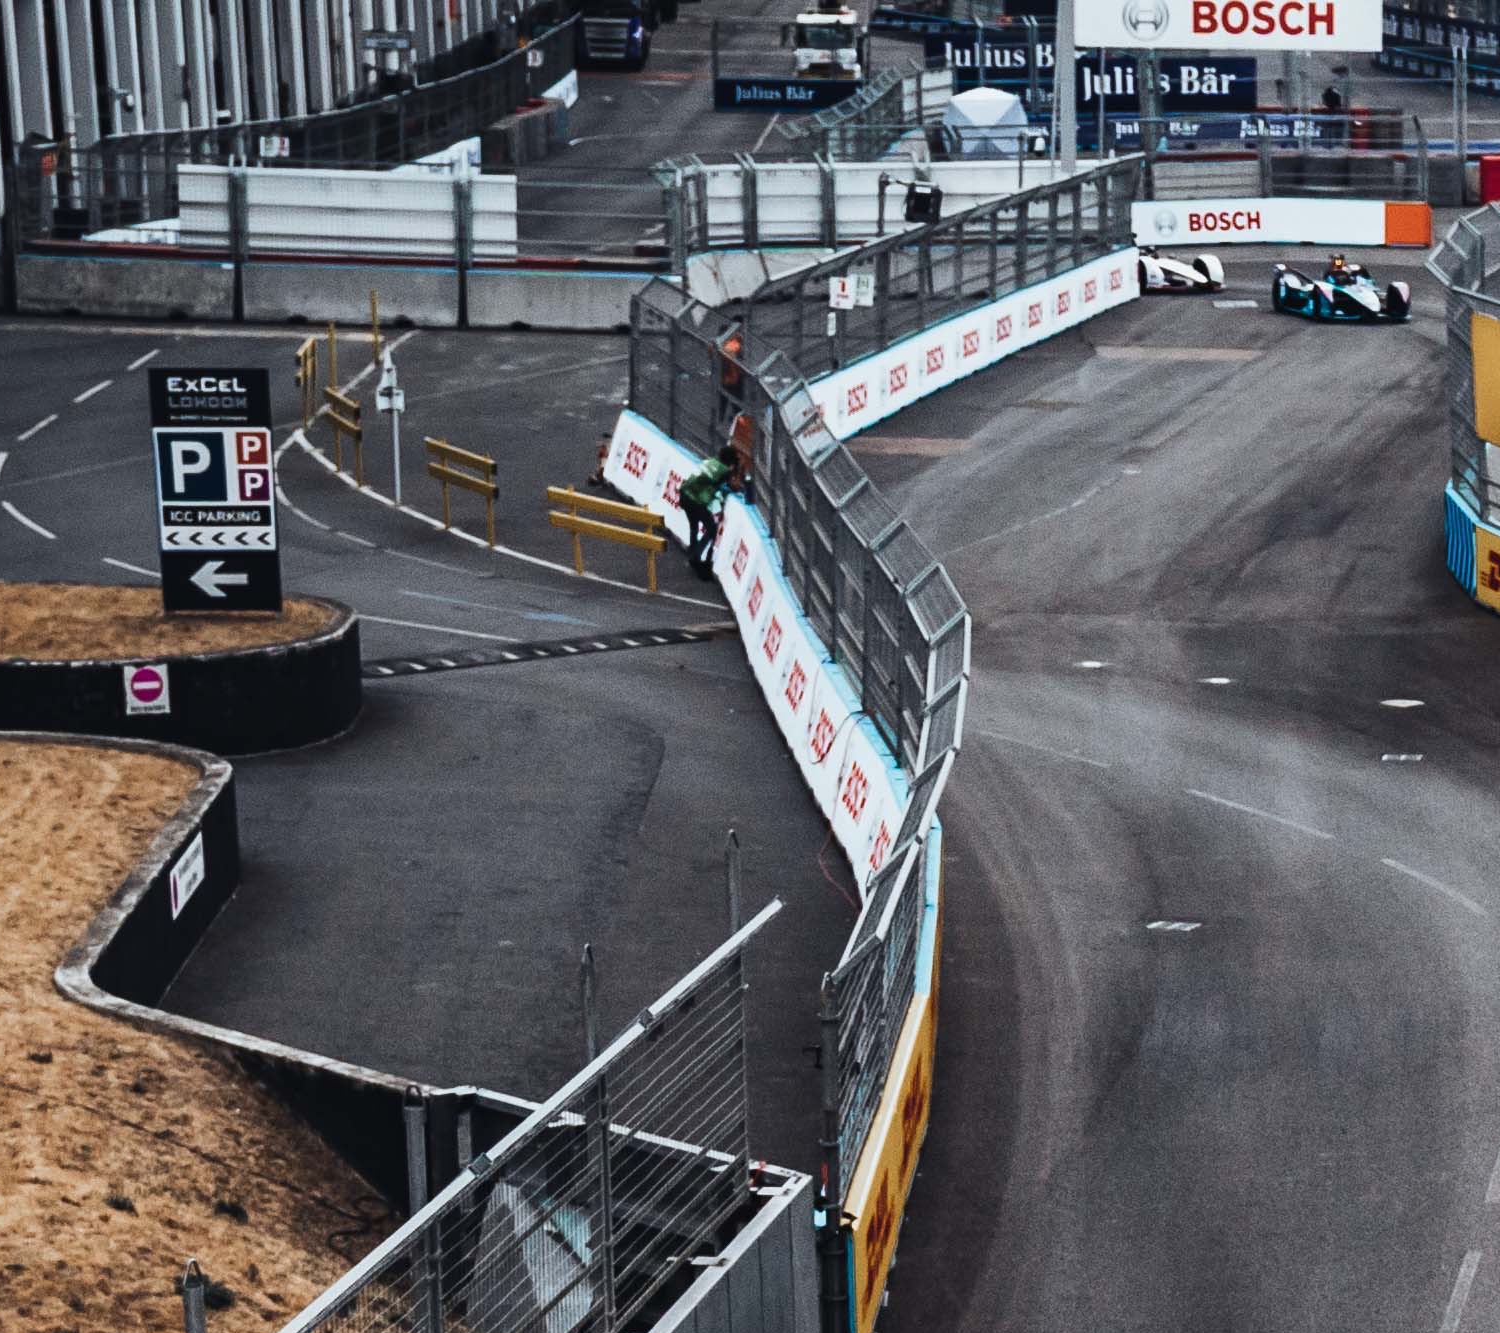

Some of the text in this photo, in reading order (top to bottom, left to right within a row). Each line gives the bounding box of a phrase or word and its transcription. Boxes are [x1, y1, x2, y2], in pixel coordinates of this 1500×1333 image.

[1193, 0, 1335, 36] BOSCH
[735, 84, 815, 101] Julius Bär
[1083, 66, 1170, 101] Julis
[1180, 65, 1237, 95] Bär
[1189, 211, 1261, 231] BOSCH
[242, 436, 261, 461] P
[171, 440, 211, 493] P
[244, 473, 264, 497] P
[170, 511, 261, 522] ICC PARKING
